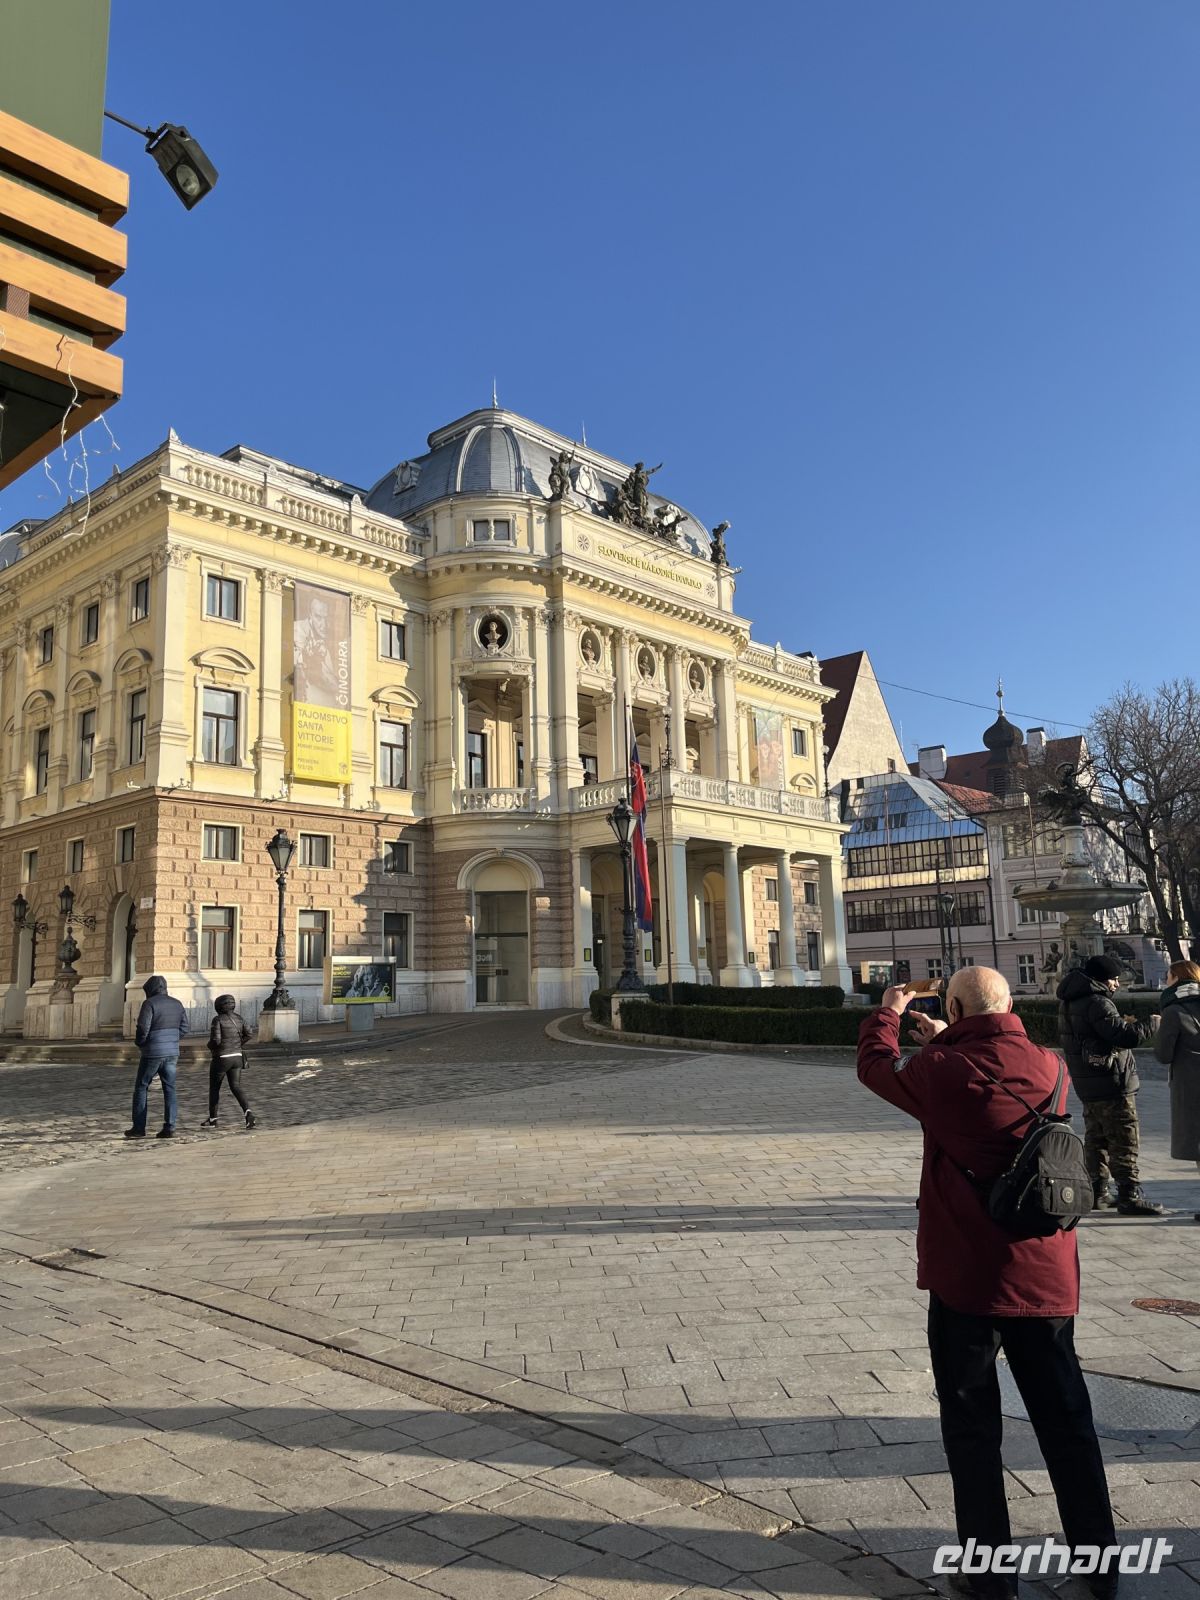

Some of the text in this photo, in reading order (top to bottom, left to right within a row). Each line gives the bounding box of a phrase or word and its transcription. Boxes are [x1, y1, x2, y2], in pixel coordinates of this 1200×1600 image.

[336, 640, 348, 705] ČINOHRA
[298, 708, 348, 725] TAJOMSTVO
[298, 720, 324, 731] SANTA
[298, 732, 334, 745] VITTORIE
